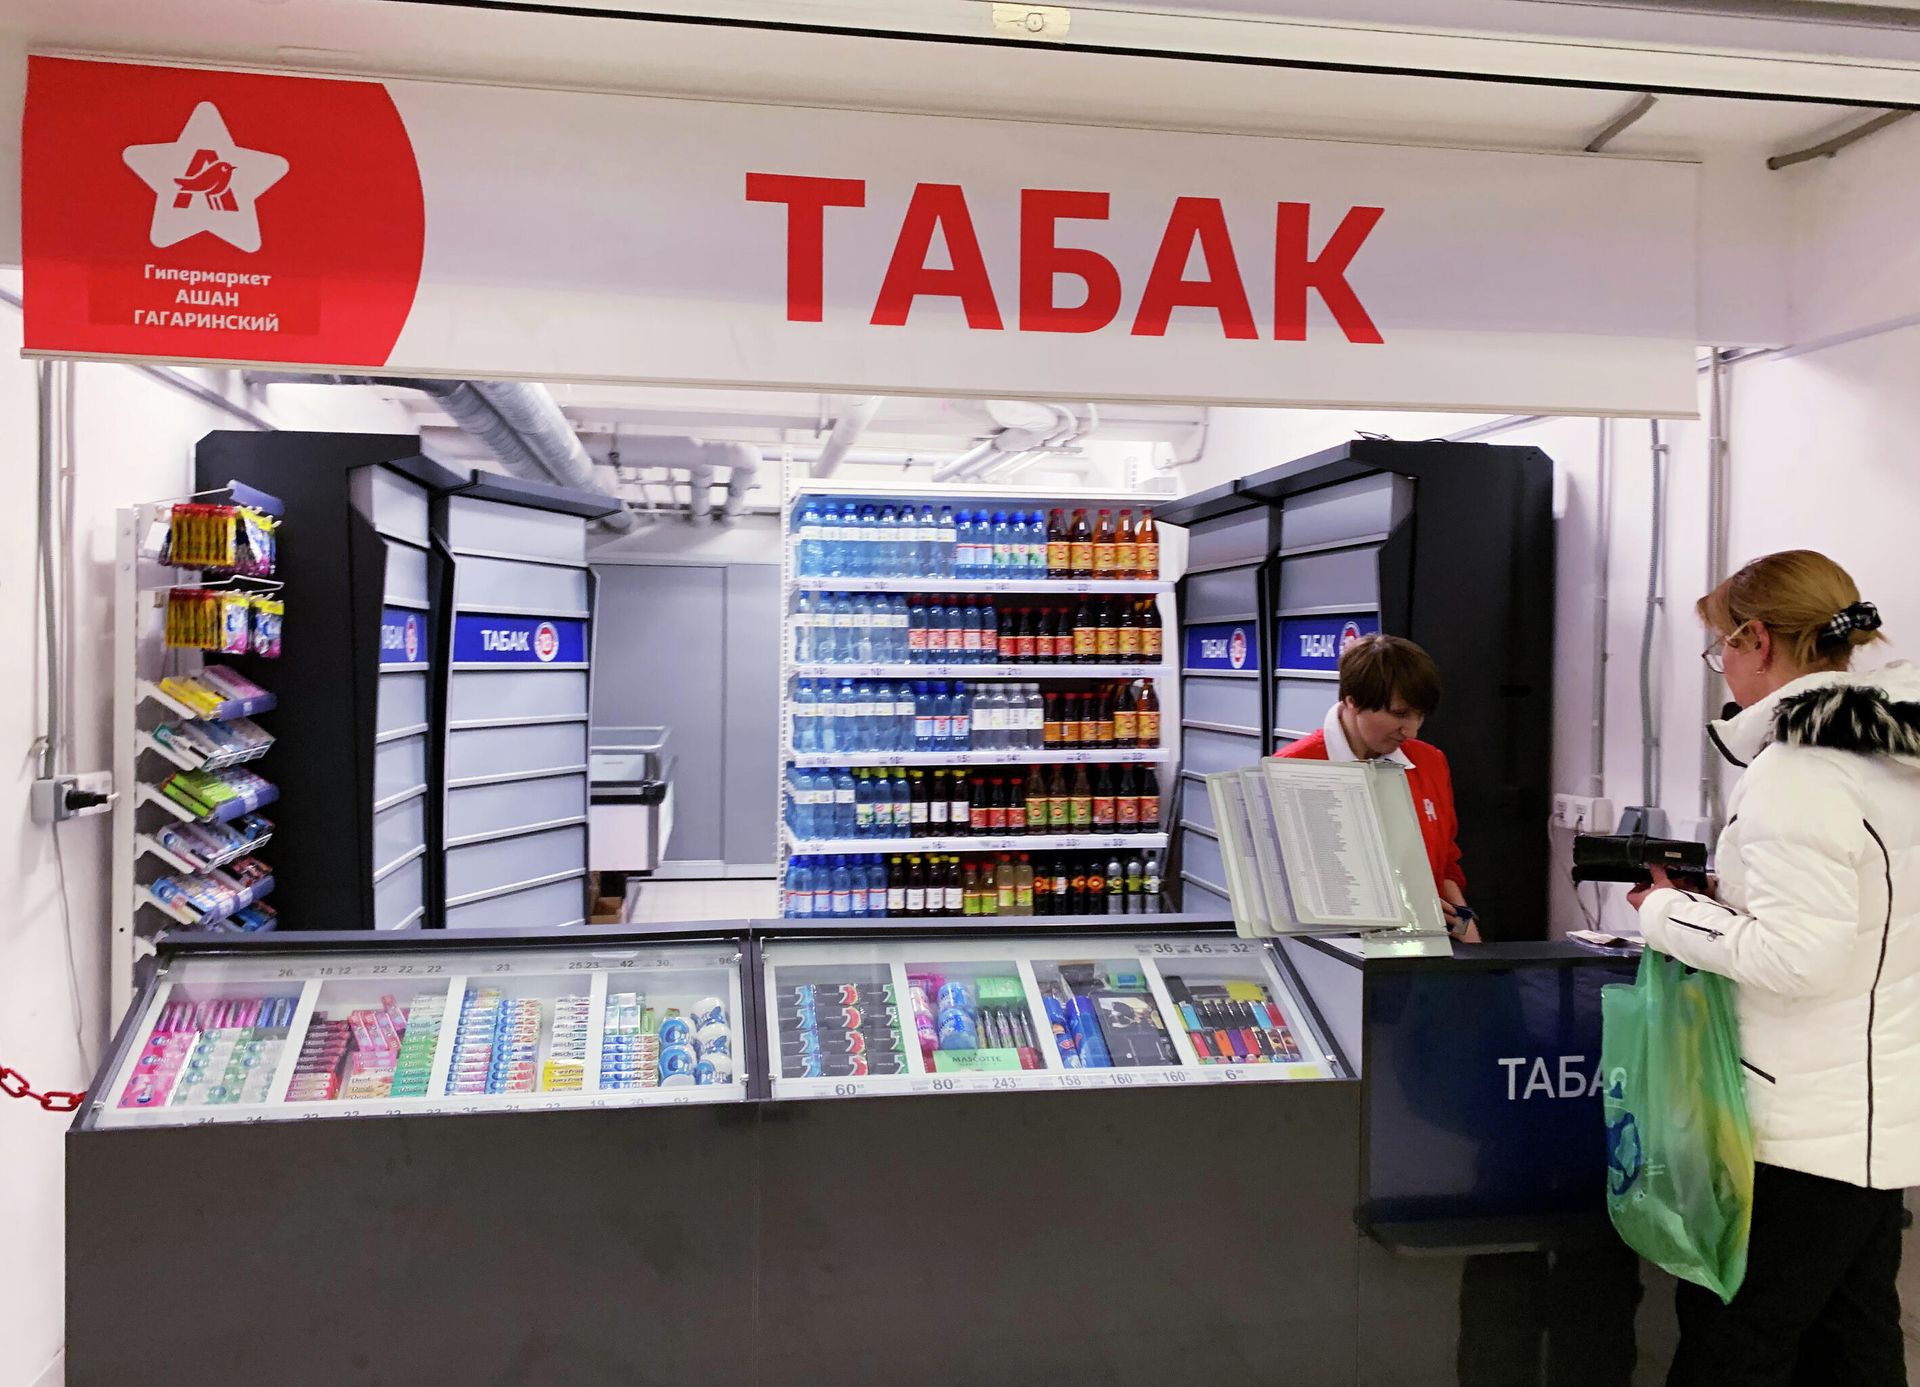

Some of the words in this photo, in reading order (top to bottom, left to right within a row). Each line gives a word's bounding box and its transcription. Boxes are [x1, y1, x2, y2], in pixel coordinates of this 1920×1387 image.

[746, 172, 1385, 345] ТАБАК
[144, 263, 272, 288] Гипермаркет
[175, 289, 239, 307] АШАН
[134, 310, 279, 332] ГАГАРИНСКИЙ
[480, 629, 530, 652] ТАБАК
[1300, 634, 1336, 658] ТАБАК
[1153, 943, 1174, 954] 36
[1193, 943, 1213, 954] 45
[1230, 943, 1250, 954] 32
[1057, 1075, 1081, 1086] 158
[1109, 1073, 1132, 1085] 160
[1163, 1071, 1186, 1082] 160
[1225, 1069, 1236, 1080] 6
[932, 1078, 953, 1090] 80
[992, 1077, 1016, 1089] 243
[835, 1083, 856, 1096] 60
